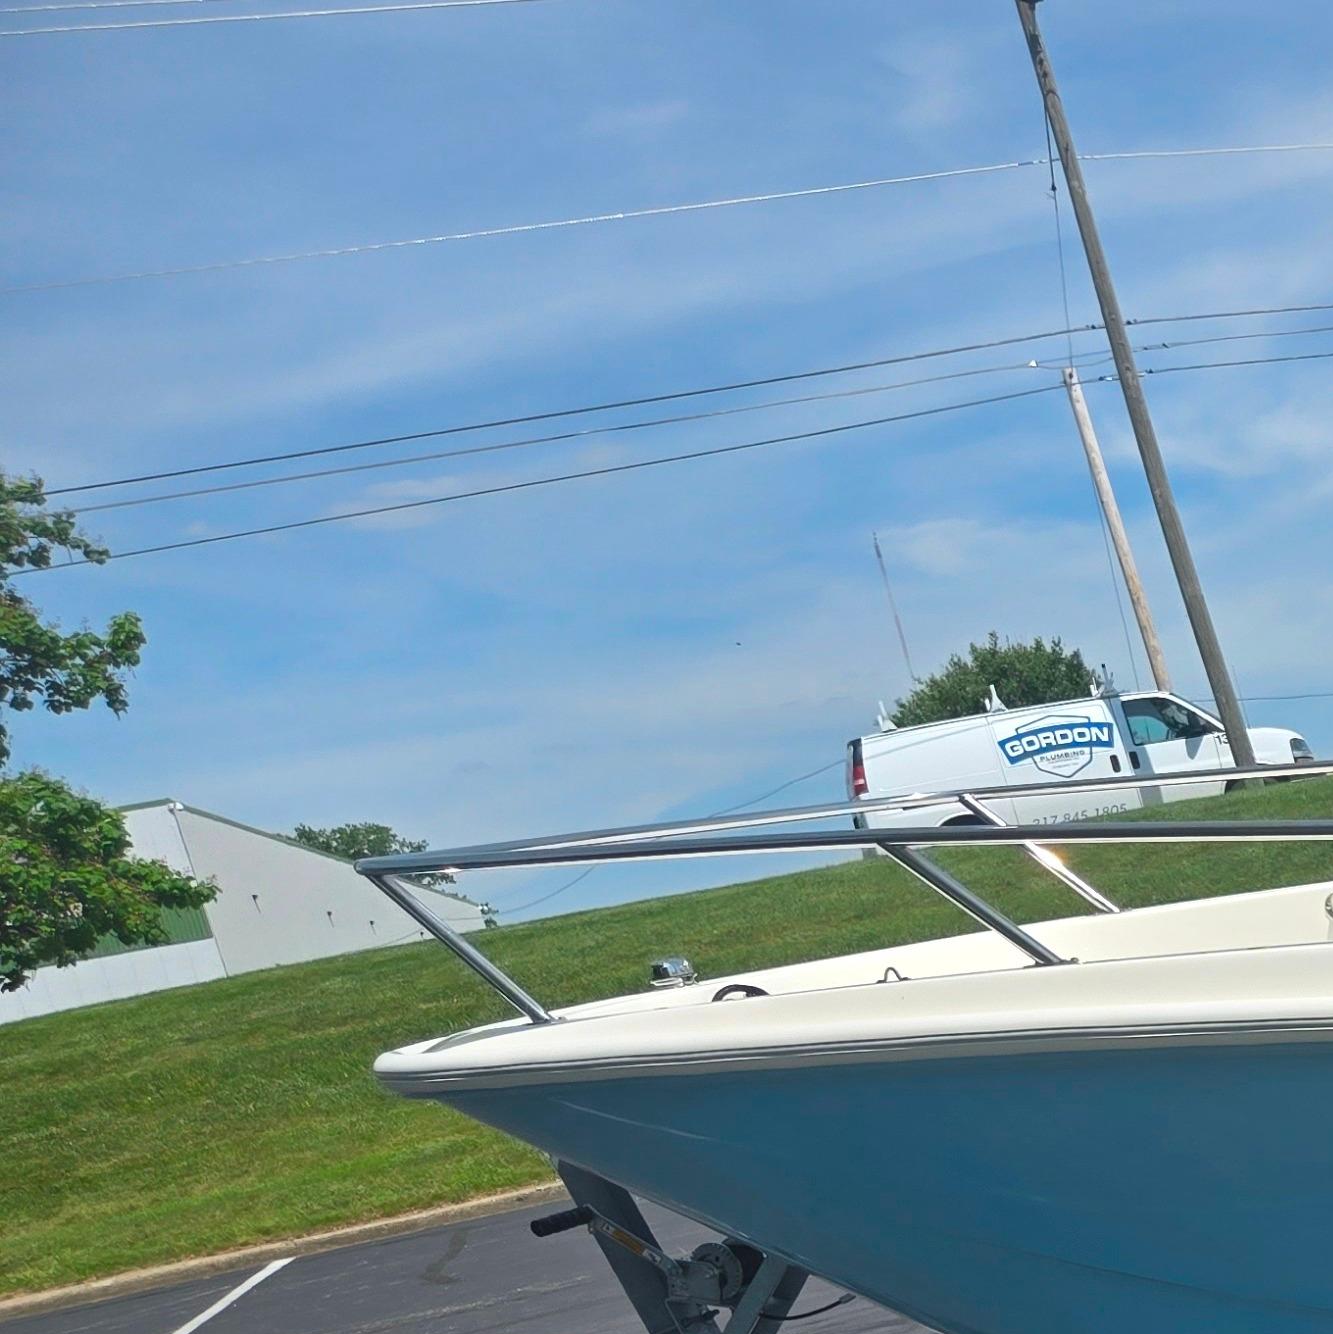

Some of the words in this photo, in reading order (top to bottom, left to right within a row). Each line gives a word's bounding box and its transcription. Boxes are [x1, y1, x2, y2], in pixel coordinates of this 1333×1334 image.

[1004, 726, 1109, 758] GORDON
[1039, 750, 1085, 762] PLUMBING
[1095, 803, 1128, 817] 1805
